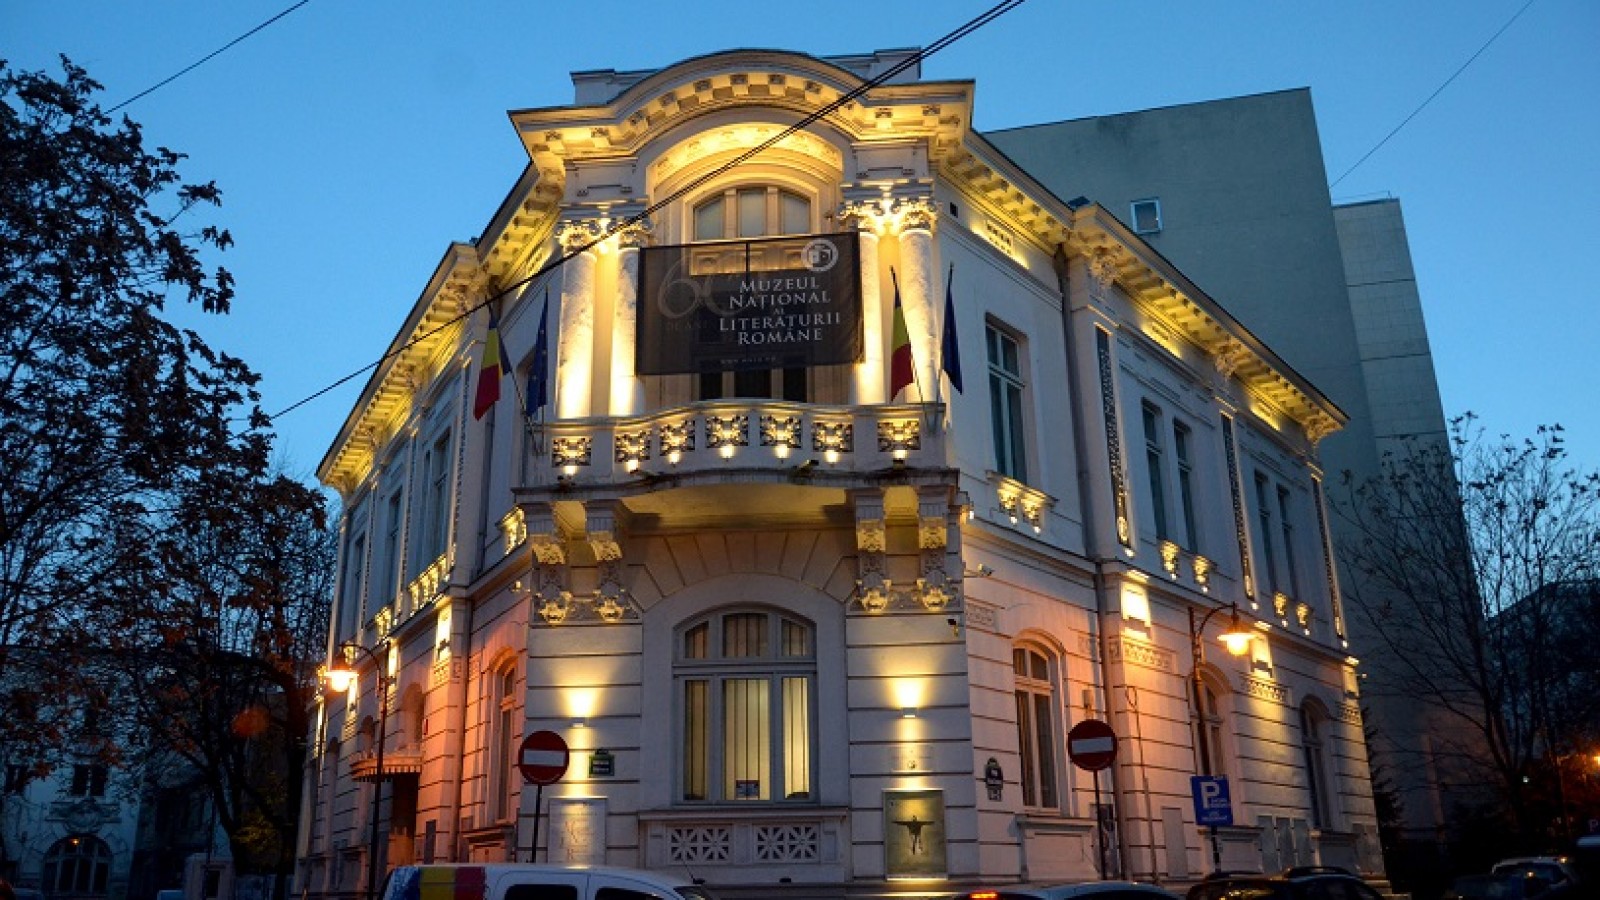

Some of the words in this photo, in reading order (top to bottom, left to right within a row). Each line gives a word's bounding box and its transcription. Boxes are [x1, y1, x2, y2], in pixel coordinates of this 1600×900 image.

[740, 276, 820, 294] MUZEUL
[720, 311, 841, 331] LITERATURII
[738, 327, 822, 345] ROMÂNE
[1201, 781, 1220, 809] P
